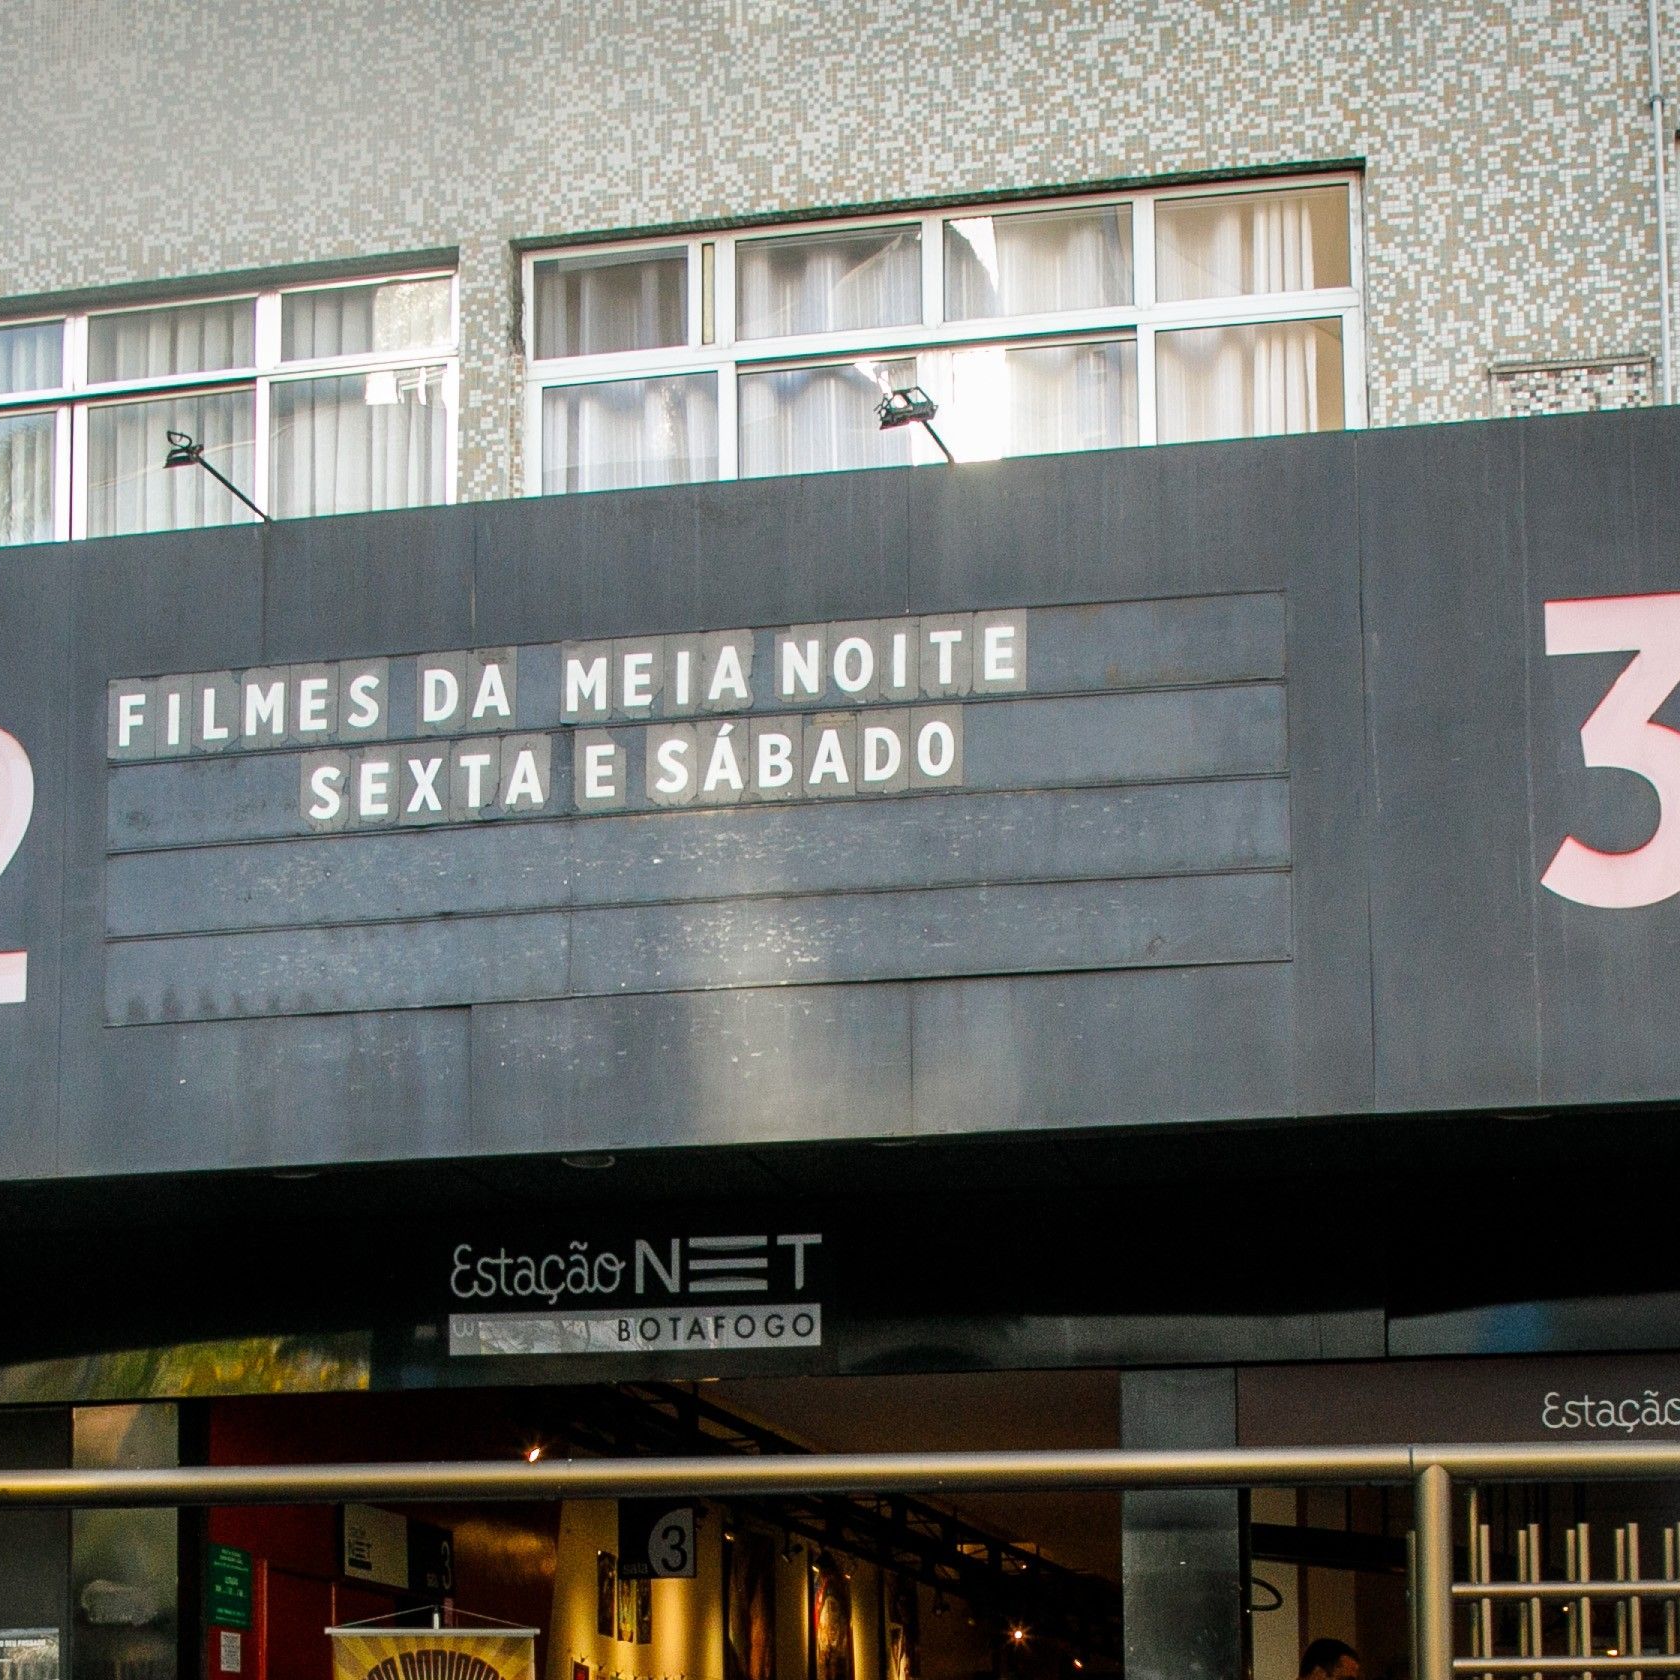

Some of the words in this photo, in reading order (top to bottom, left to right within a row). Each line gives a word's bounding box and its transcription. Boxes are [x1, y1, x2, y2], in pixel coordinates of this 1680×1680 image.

[117, 673, 380, 748] FILMES
[422, 662, 512, 724] DA
[564, 643, 750, 713] MEIA
[781, 622, 1018, 696] NOITE
[307, 748, 542, 821] SEXTA
[583, 742, 617, 800] E
[655, 719, 956, 797] SÁBADO
[450, 1241, 625, 1305] Estação
[635, 1233, 823, 1295] NET
[618, 1312, 815, 1343] BOTAFOGO
[661, 1524, 688, 1573] 3
